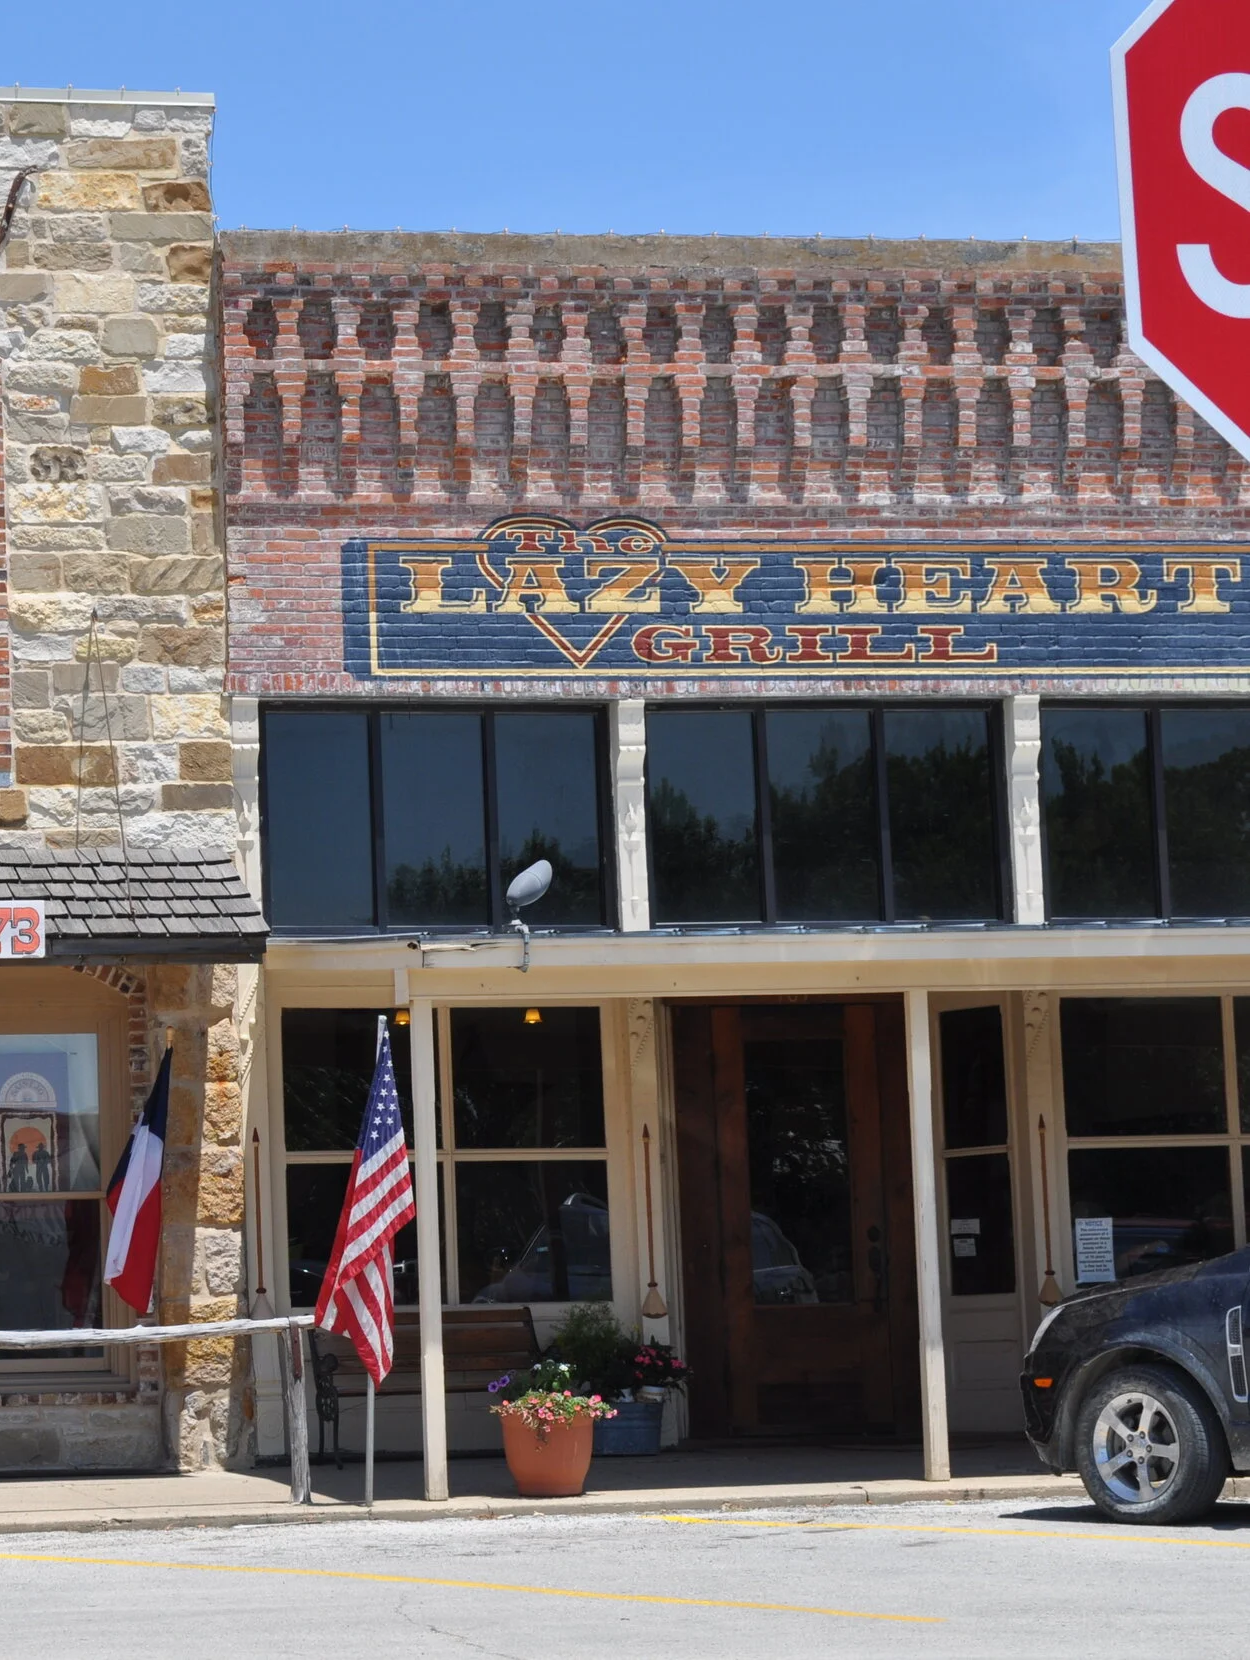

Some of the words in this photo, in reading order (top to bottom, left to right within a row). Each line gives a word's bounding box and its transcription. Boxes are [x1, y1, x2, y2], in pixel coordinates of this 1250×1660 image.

[504, 529, 655, 553] The
[399, 556, 761, 614] LAZY
[793, 556, 1241, 614] HEART
[632, 625, 998, 664] GRILL
